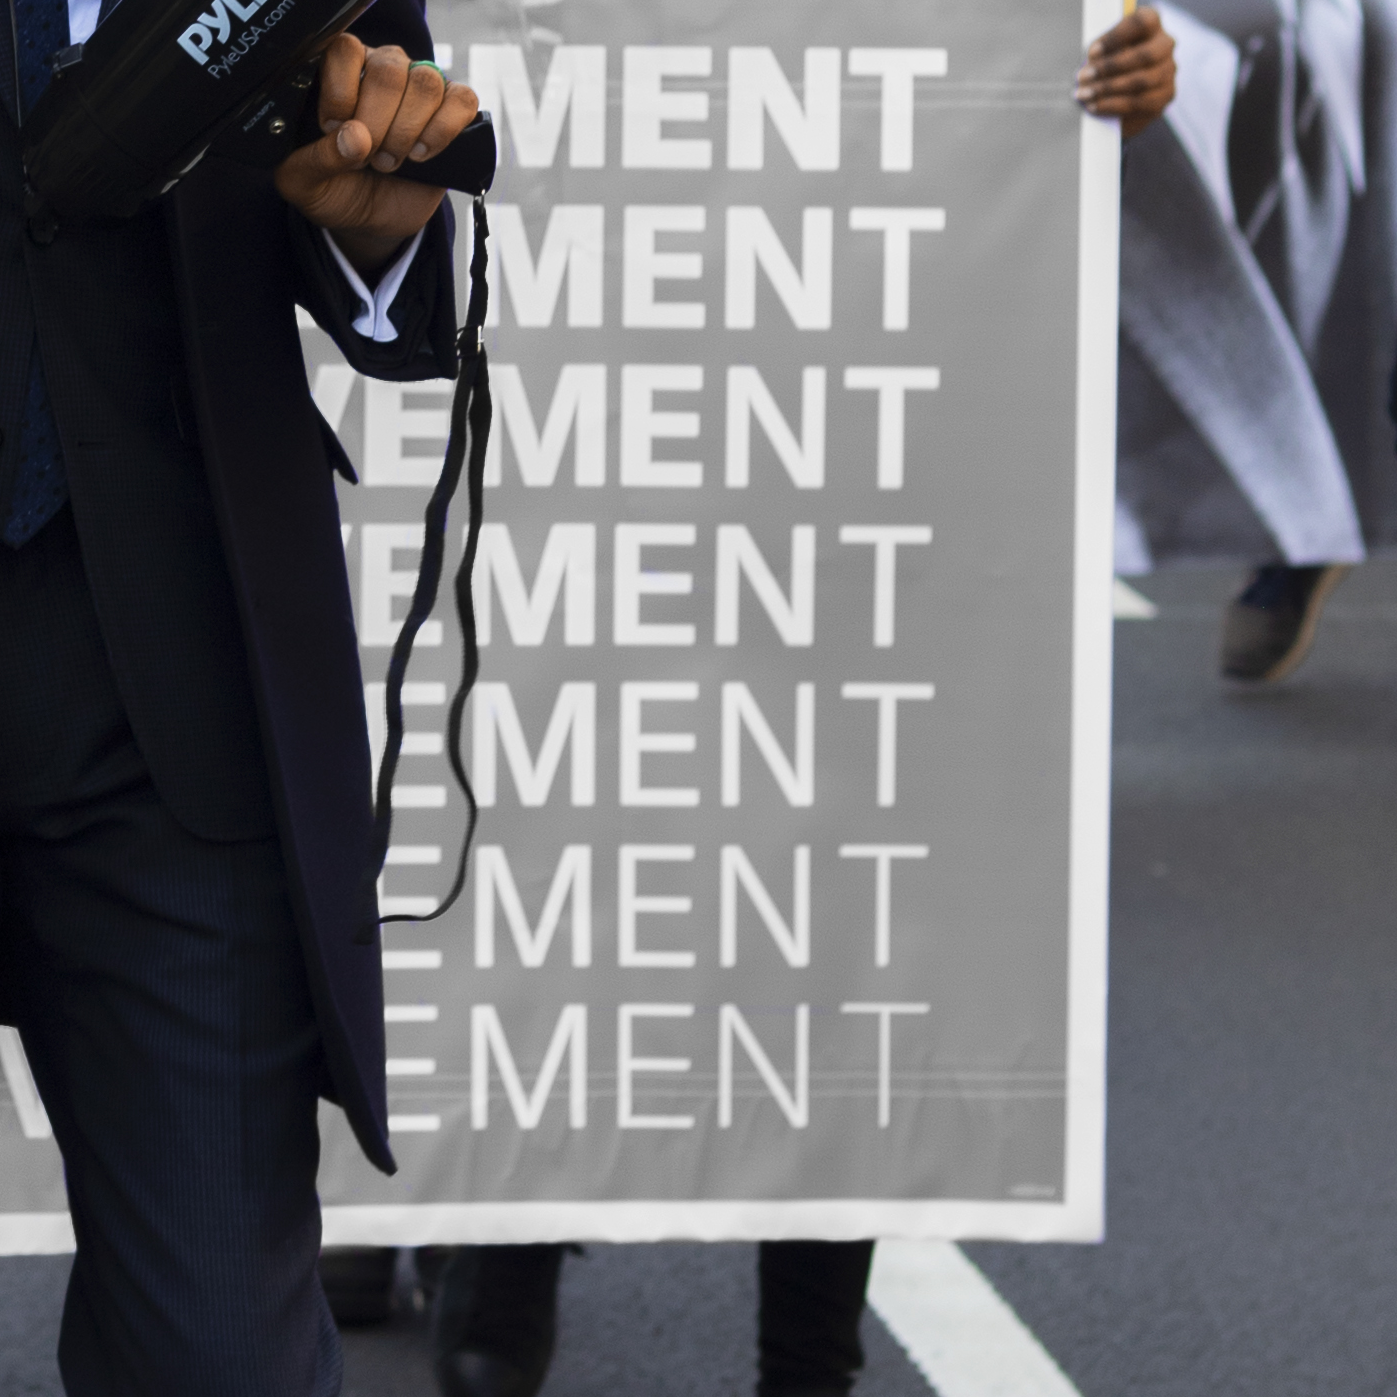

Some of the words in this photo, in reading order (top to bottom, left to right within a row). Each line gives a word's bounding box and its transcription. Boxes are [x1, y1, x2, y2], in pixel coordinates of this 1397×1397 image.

[432, 44, 949, 172] MENT
[457, 204, 947, 331] MENT
[341, 522, 934, 648] EMENT
[366, 681, 936, 808] EMENT
[377, 844, 930, 969] EMENT
[384, 1003, 931, 1131] EMENT
